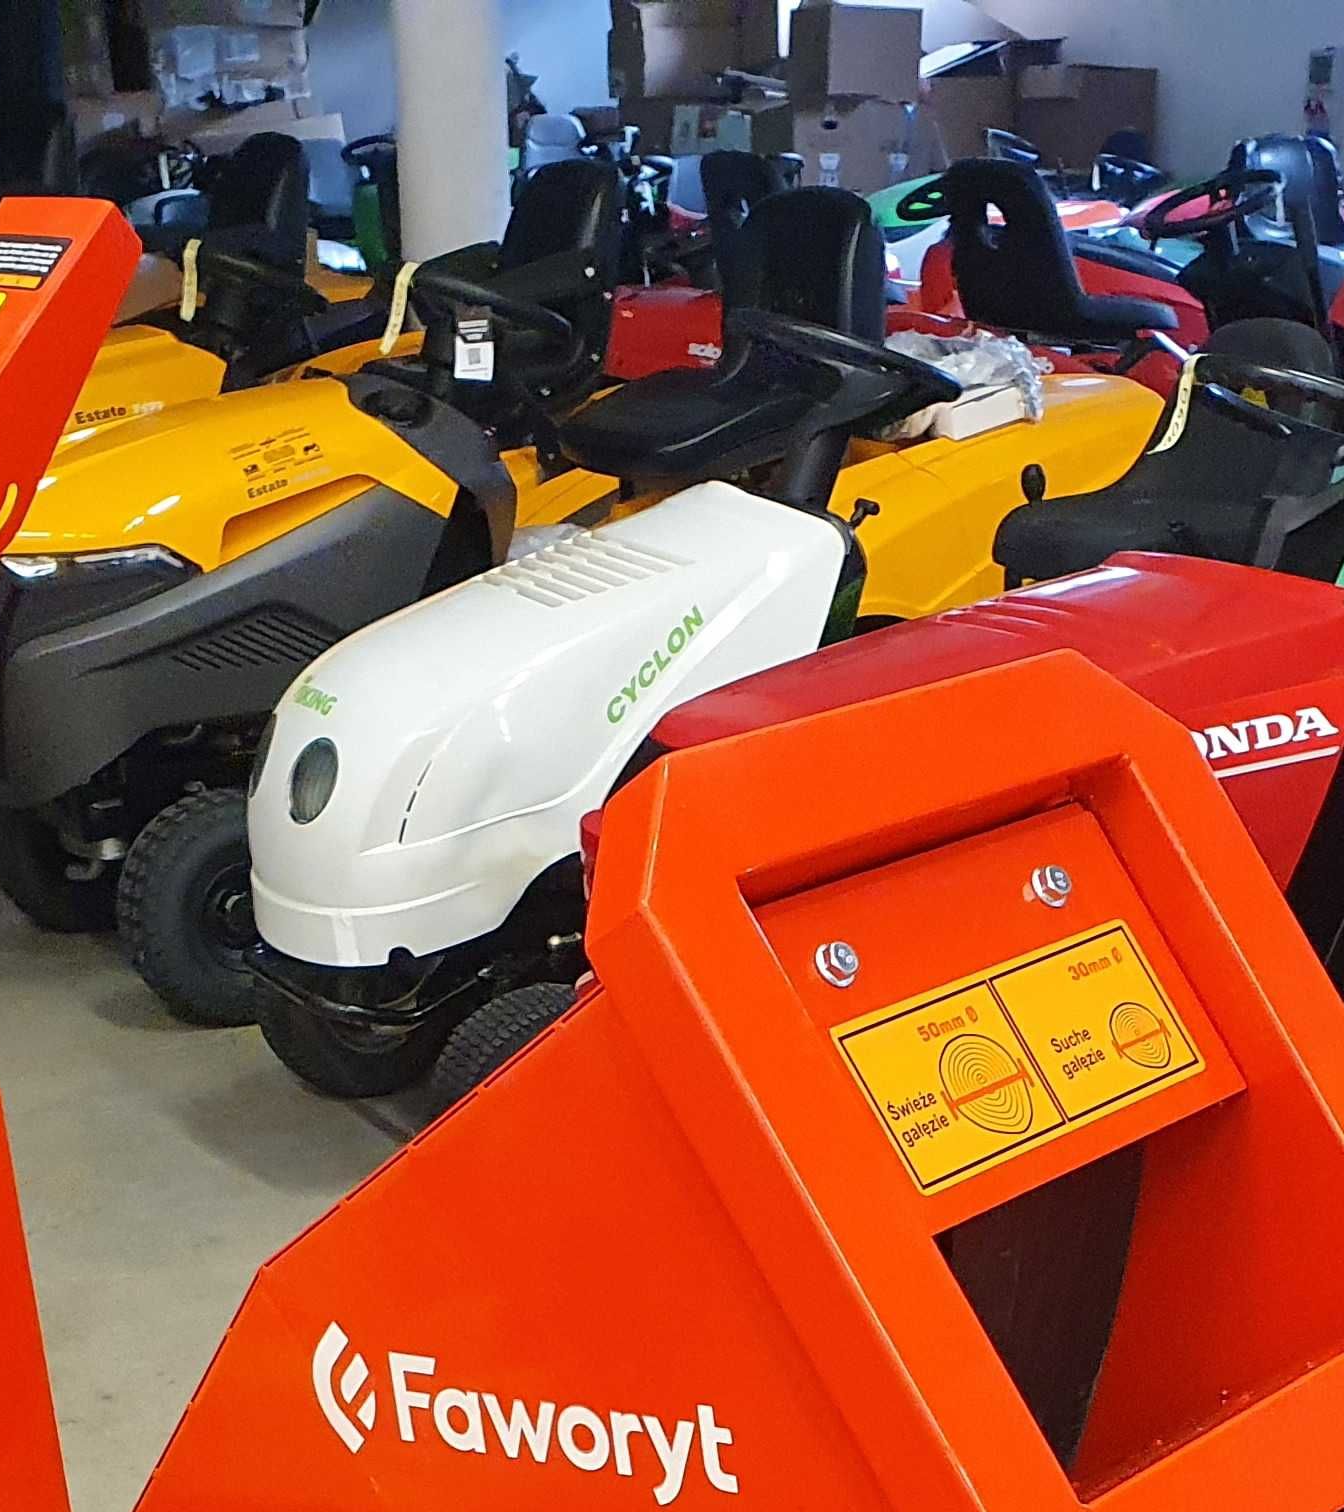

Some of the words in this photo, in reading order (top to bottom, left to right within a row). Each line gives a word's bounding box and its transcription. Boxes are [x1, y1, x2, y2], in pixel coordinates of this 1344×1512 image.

[606, 605, 705, 725] CYCLON
[1067, 956, 1110, 982] 30mm
[916, 1015, 966, 1043] 50mm
[1050, 1027, 1092, 1054] Suche
[387, 1350, 740, 1506] Faworyt
